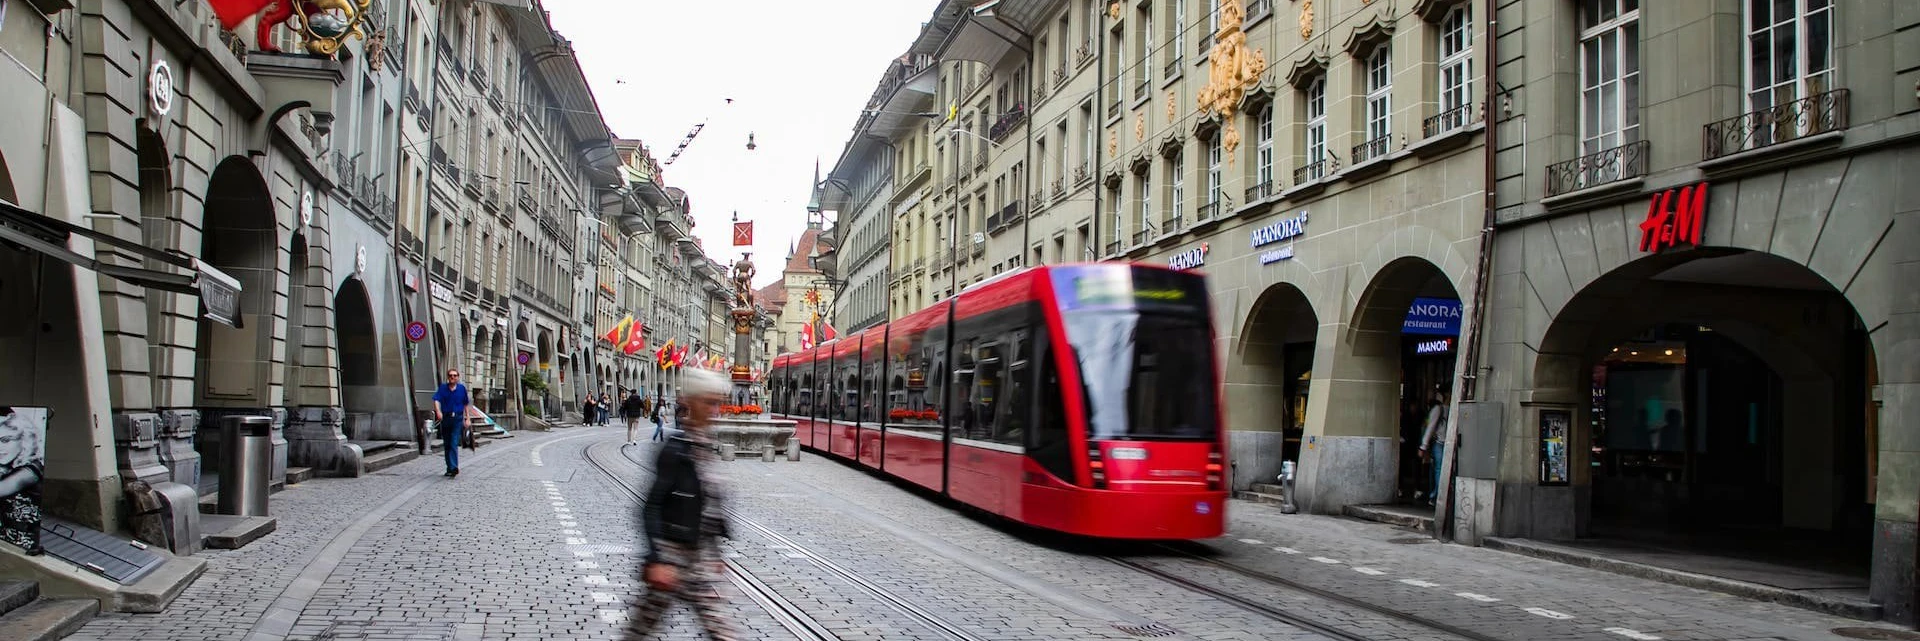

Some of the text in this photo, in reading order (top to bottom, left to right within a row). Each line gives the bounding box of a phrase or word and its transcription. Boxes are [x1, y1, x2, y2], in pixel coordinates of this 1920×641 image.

[1640, 182, 1709, 253] H&M
[1251, 216, 1303, 247] MANORA
[1168, 247, 1204, 271] MANOR
[1408, 304, 1460, 318] ANORA
[1403, 320, 1447, 329] restaurant
[1417, 340, 1448, 353] MANOR
